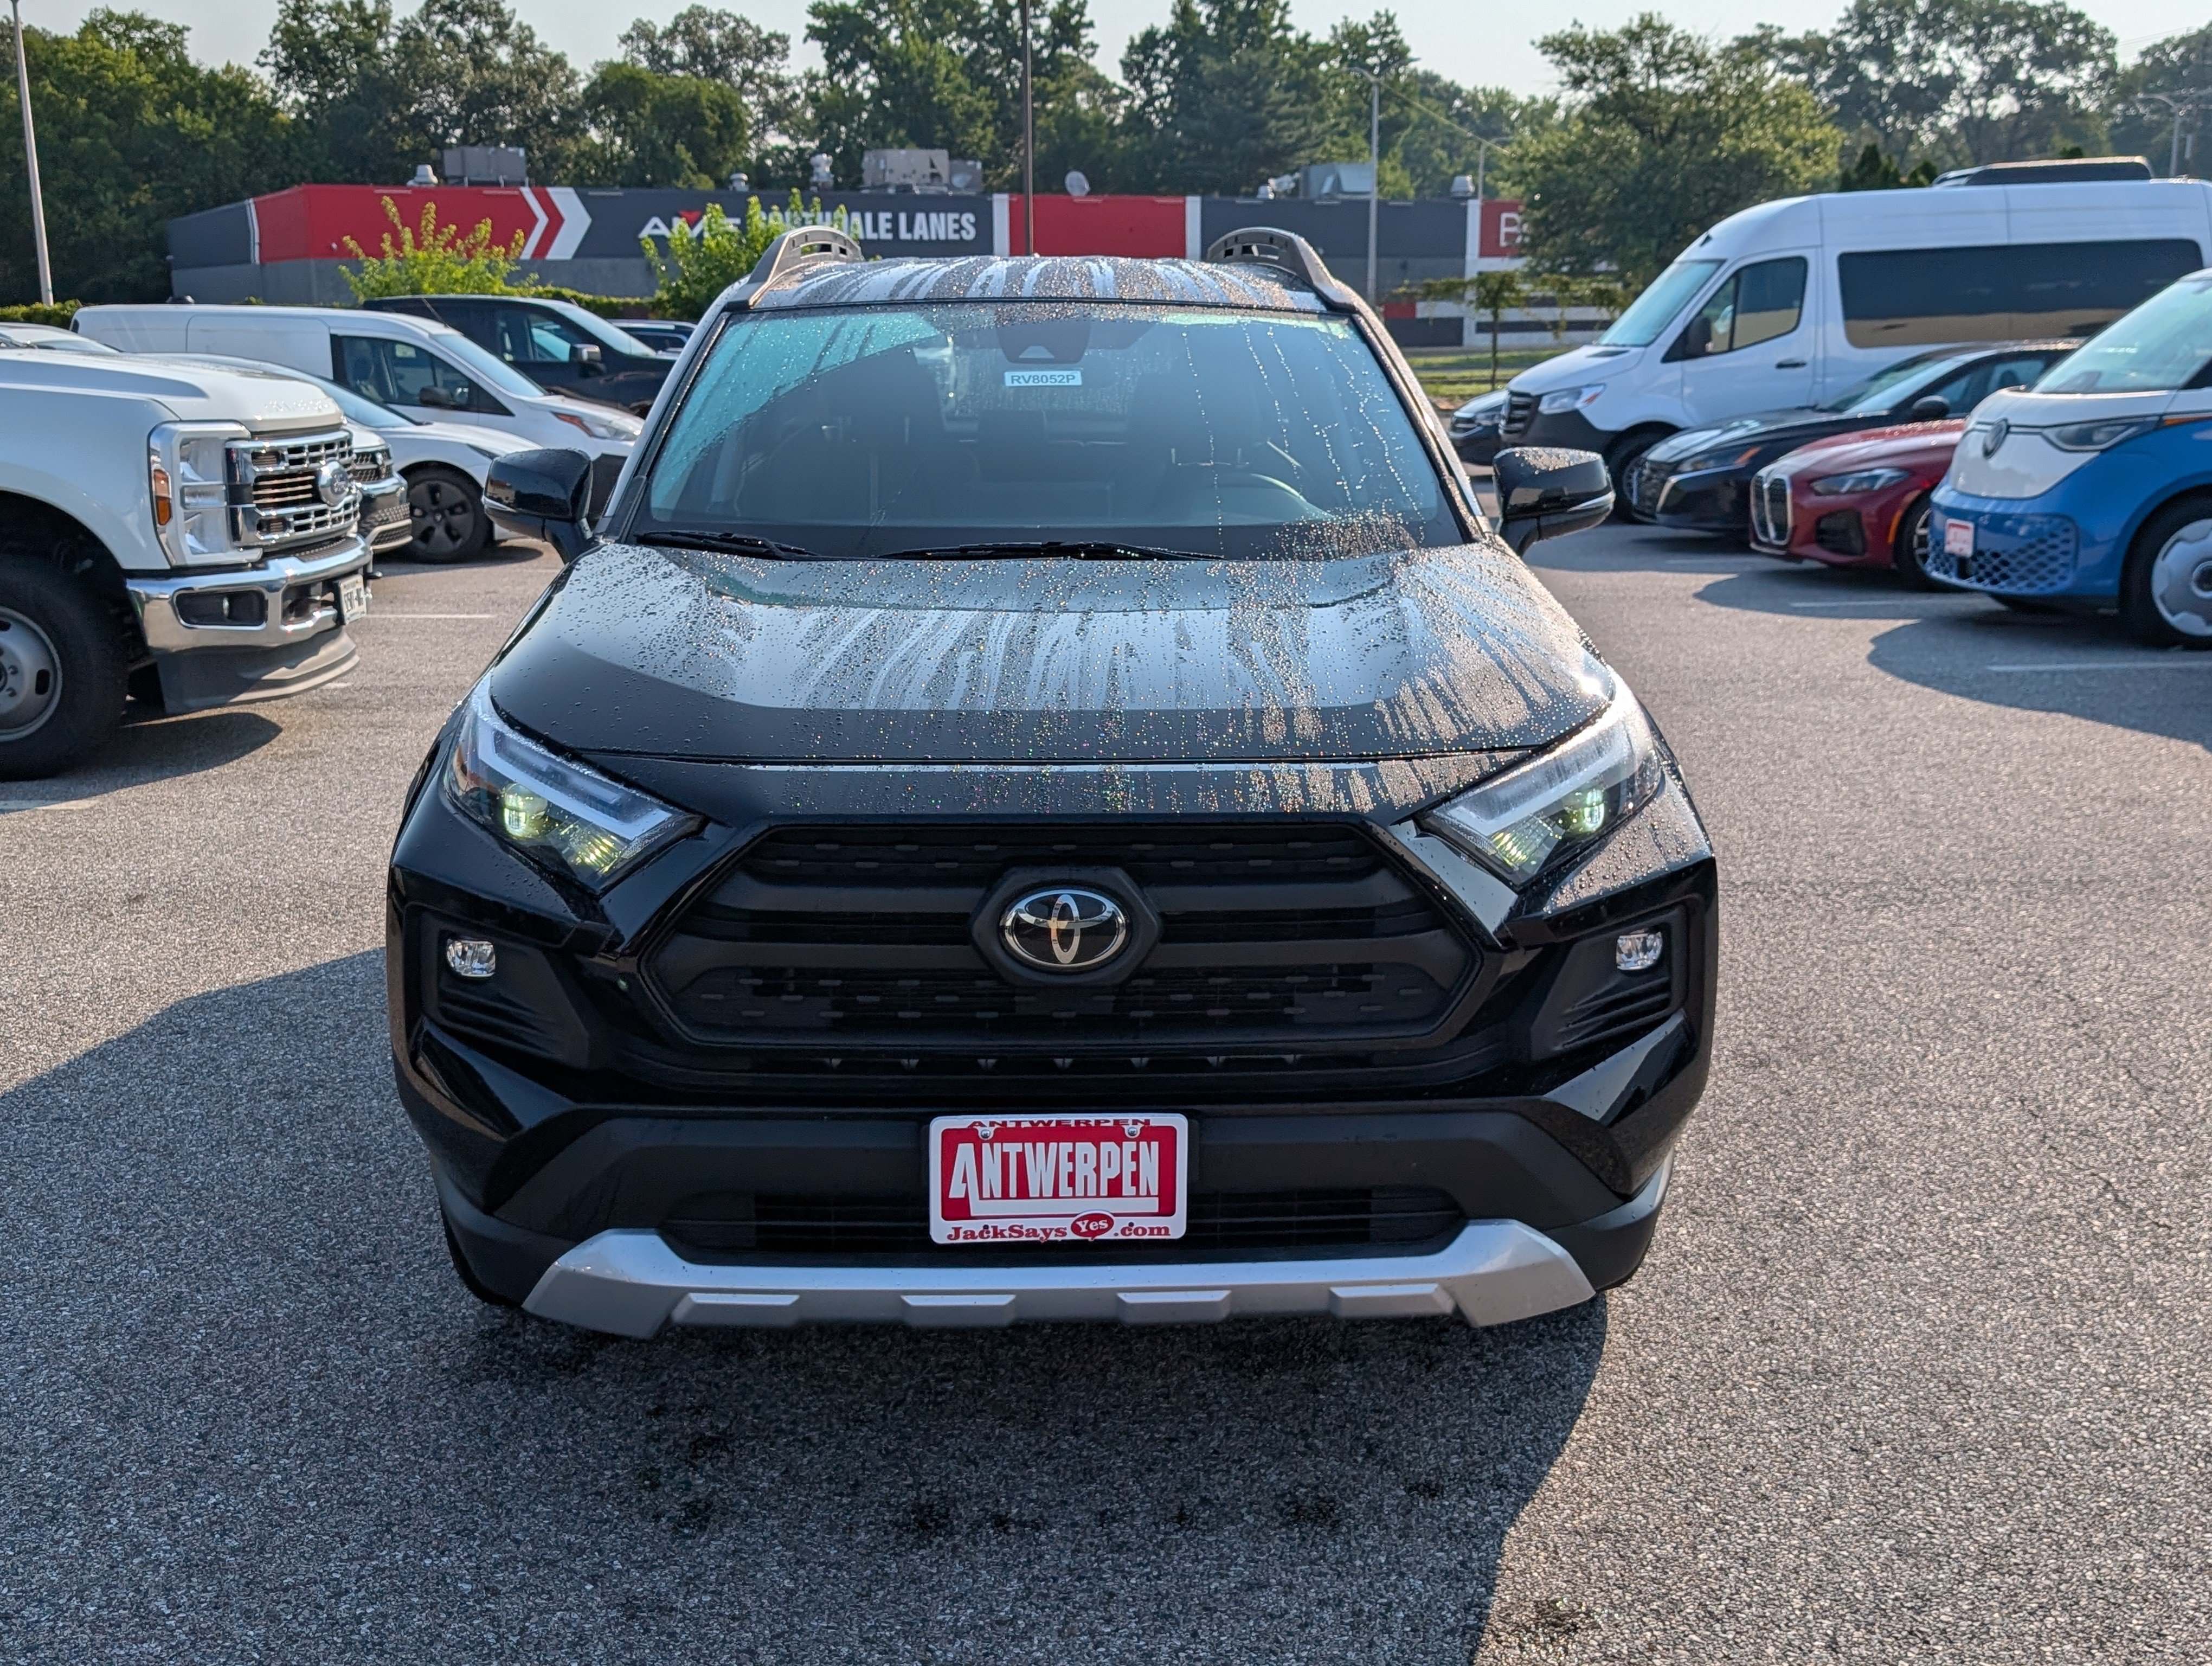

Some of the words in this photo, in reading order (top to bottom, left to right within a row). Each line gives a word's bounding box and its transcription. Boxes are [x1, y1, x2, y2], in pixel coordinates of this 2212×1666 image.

[899, 211, 976, 240] LANES
[1010, 374, 1076, 384] RV8052P
[967, 1119, 1151, 1128] ANTWERPEN
[948, 1141, 1160, 1216] ANTWERPEN
[947, 1223, 1068, 1243] JackSays
[1075, 1219, 1109, 1233] Yes
